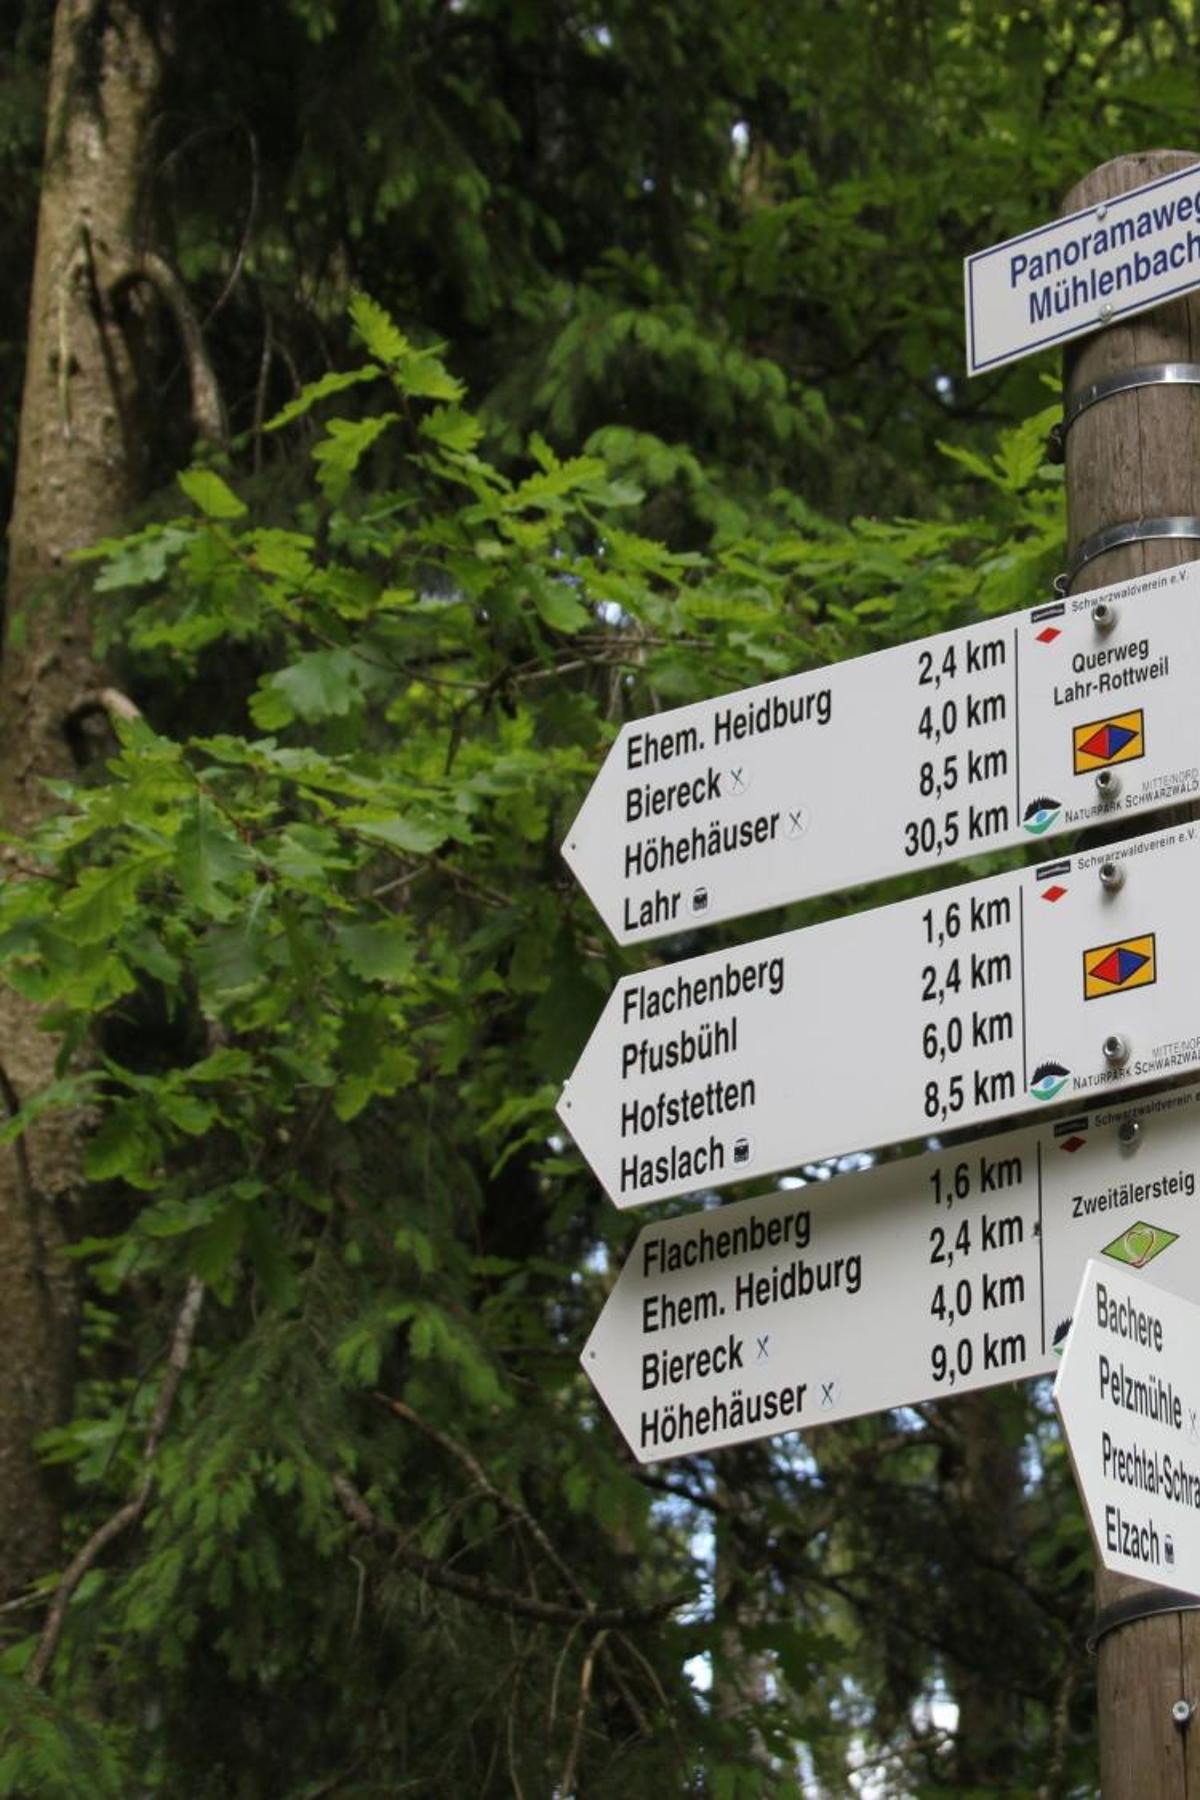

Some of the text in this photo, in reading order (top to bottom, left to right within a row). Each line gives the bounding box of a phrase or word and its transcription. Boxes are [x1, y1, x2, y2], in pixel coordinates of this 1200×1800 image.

[627, 639, 1005, 770] Ehem. Heidburg 2,4 km
[1053, 656, 1168, 706] Lahr-Rottweil
[1072, 638, 1149, 674] Querweg
[624, 749, 1007, 879] Höhehäuser 8,5 km
[626, 694, 1006, 822] Biereck 4,0 km
[1126, 780, 1199, 808] SCHWARZWALD
[623, 804, 1008, 931] Lahr 30,5 km
[622, 953, 1011, 1079] Pfusbühl 2,4 km
[623, 896, 1011, 1024] Flachenberg 1,6 km
[620, 1069, 1015, 1192] Haslach 8,5 km
[621, 1011, 1013, 1137] Hofstetten 6,0 km
[643, 1156, 1022, 1278] Flachenberg 1,6 km
[1072, 1170, 1195, 1218] Zweitälersteig
[642, 1273, 1024, 1391] Biereck 4,0 km
[643, 1214, 1023, 1333] Ehem. Heidburg 2,4 km
[1096, 1282, 1163, 1353] Bachere
[640, 1332, 1026, 1448] Höhehäuser 9,0 km
[1099, 1354, 1182, 1430] Pelzmühle
[1105, 1504, 1161, 1565] Elzach
